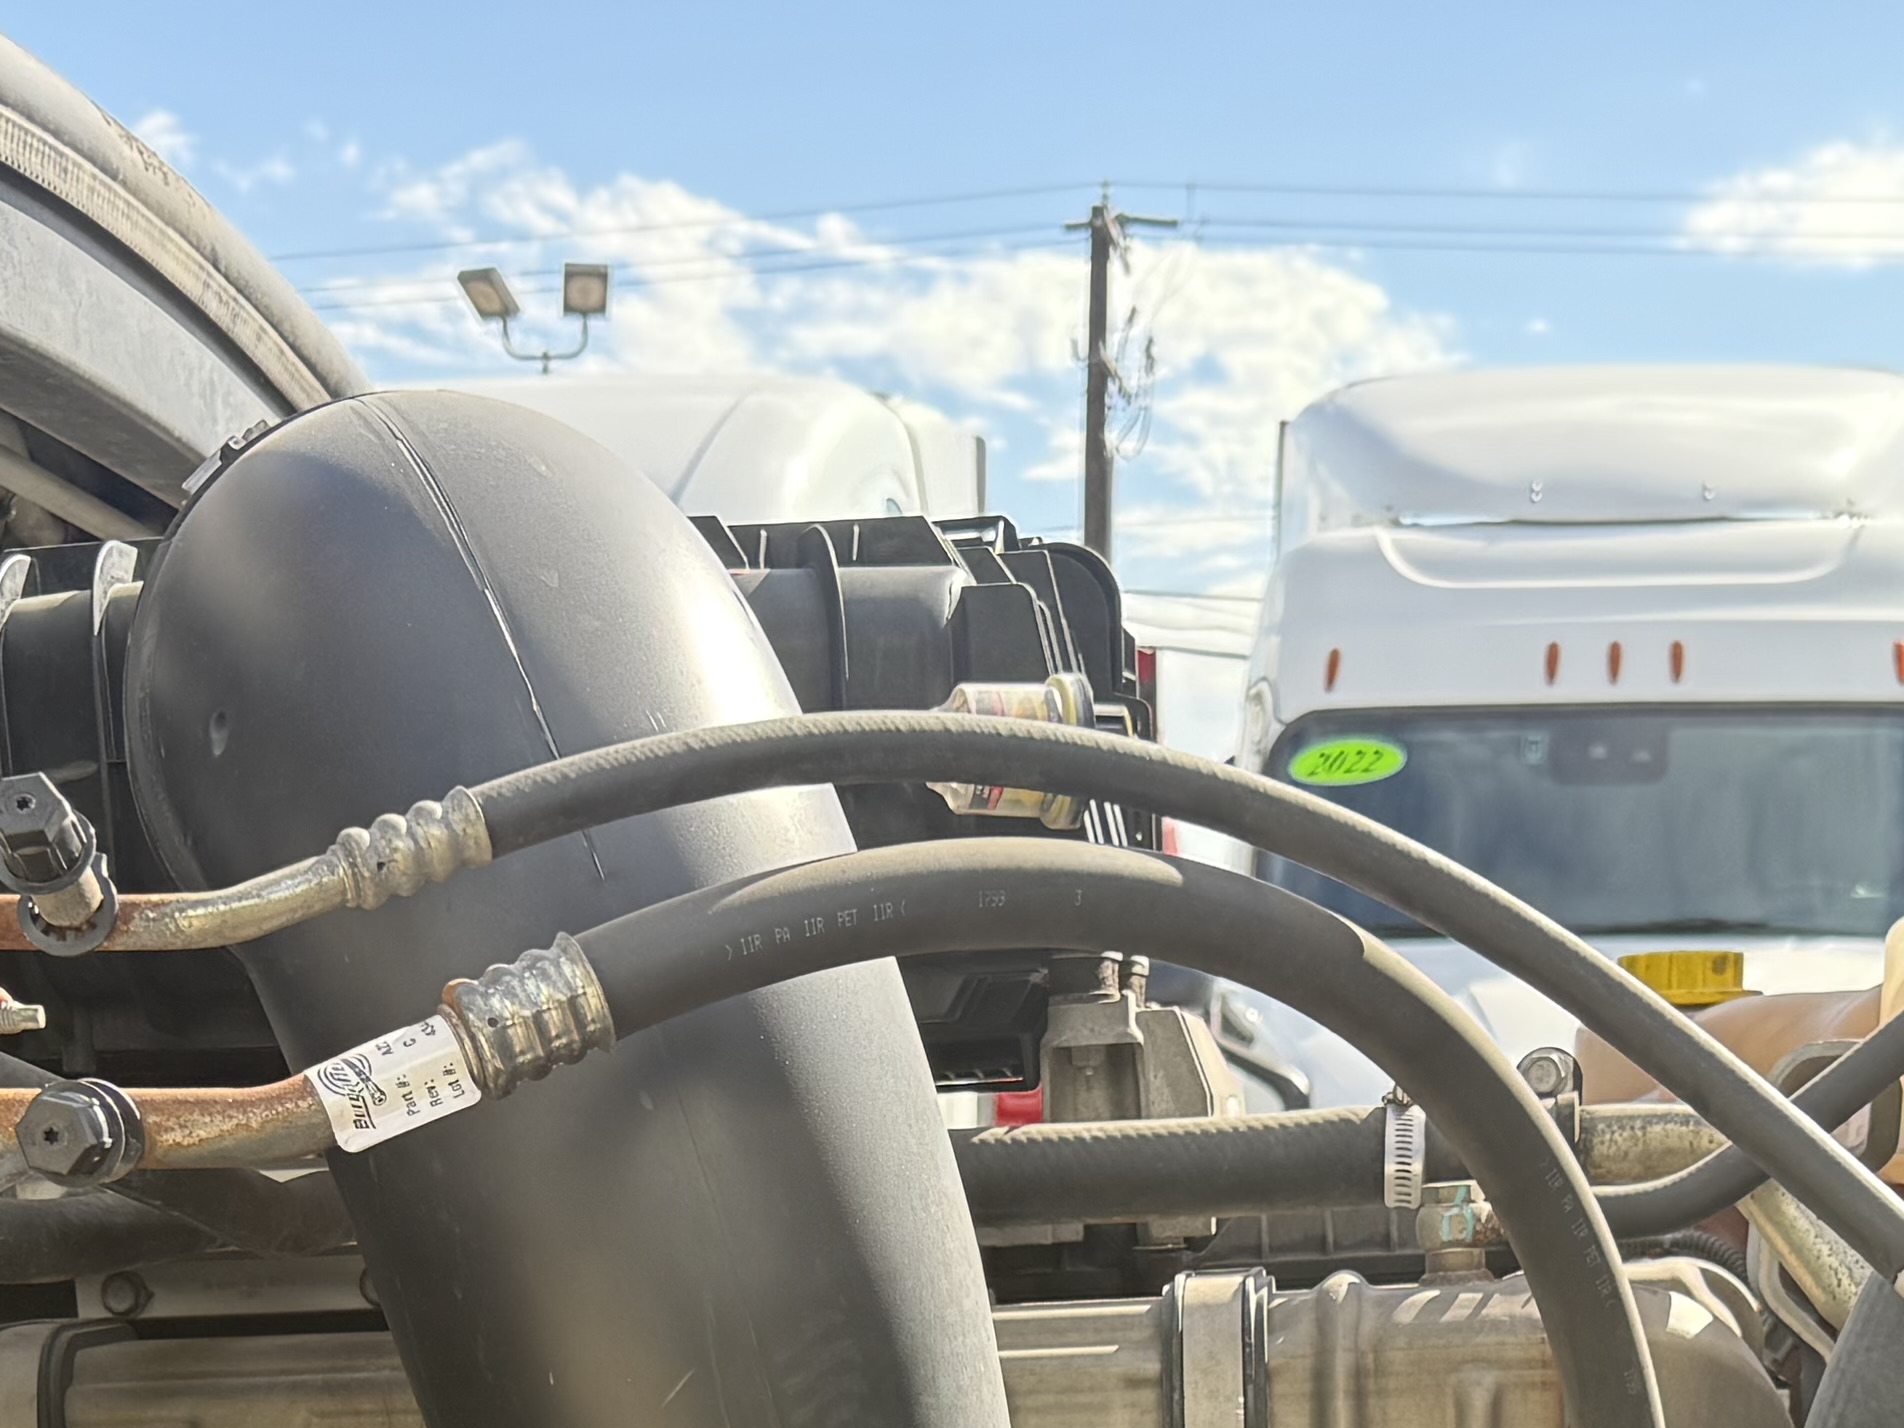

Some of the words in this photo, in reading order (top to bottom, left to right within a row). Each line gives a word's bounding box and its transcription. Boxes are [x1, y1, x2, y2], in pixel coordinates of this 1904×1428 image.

[1307, 748, 1384, 777] 2022
[837, 908, 859, 927] PET
[448, 1079, 465, 1099] Lot
[402, 1091, 420, 1117] Part
